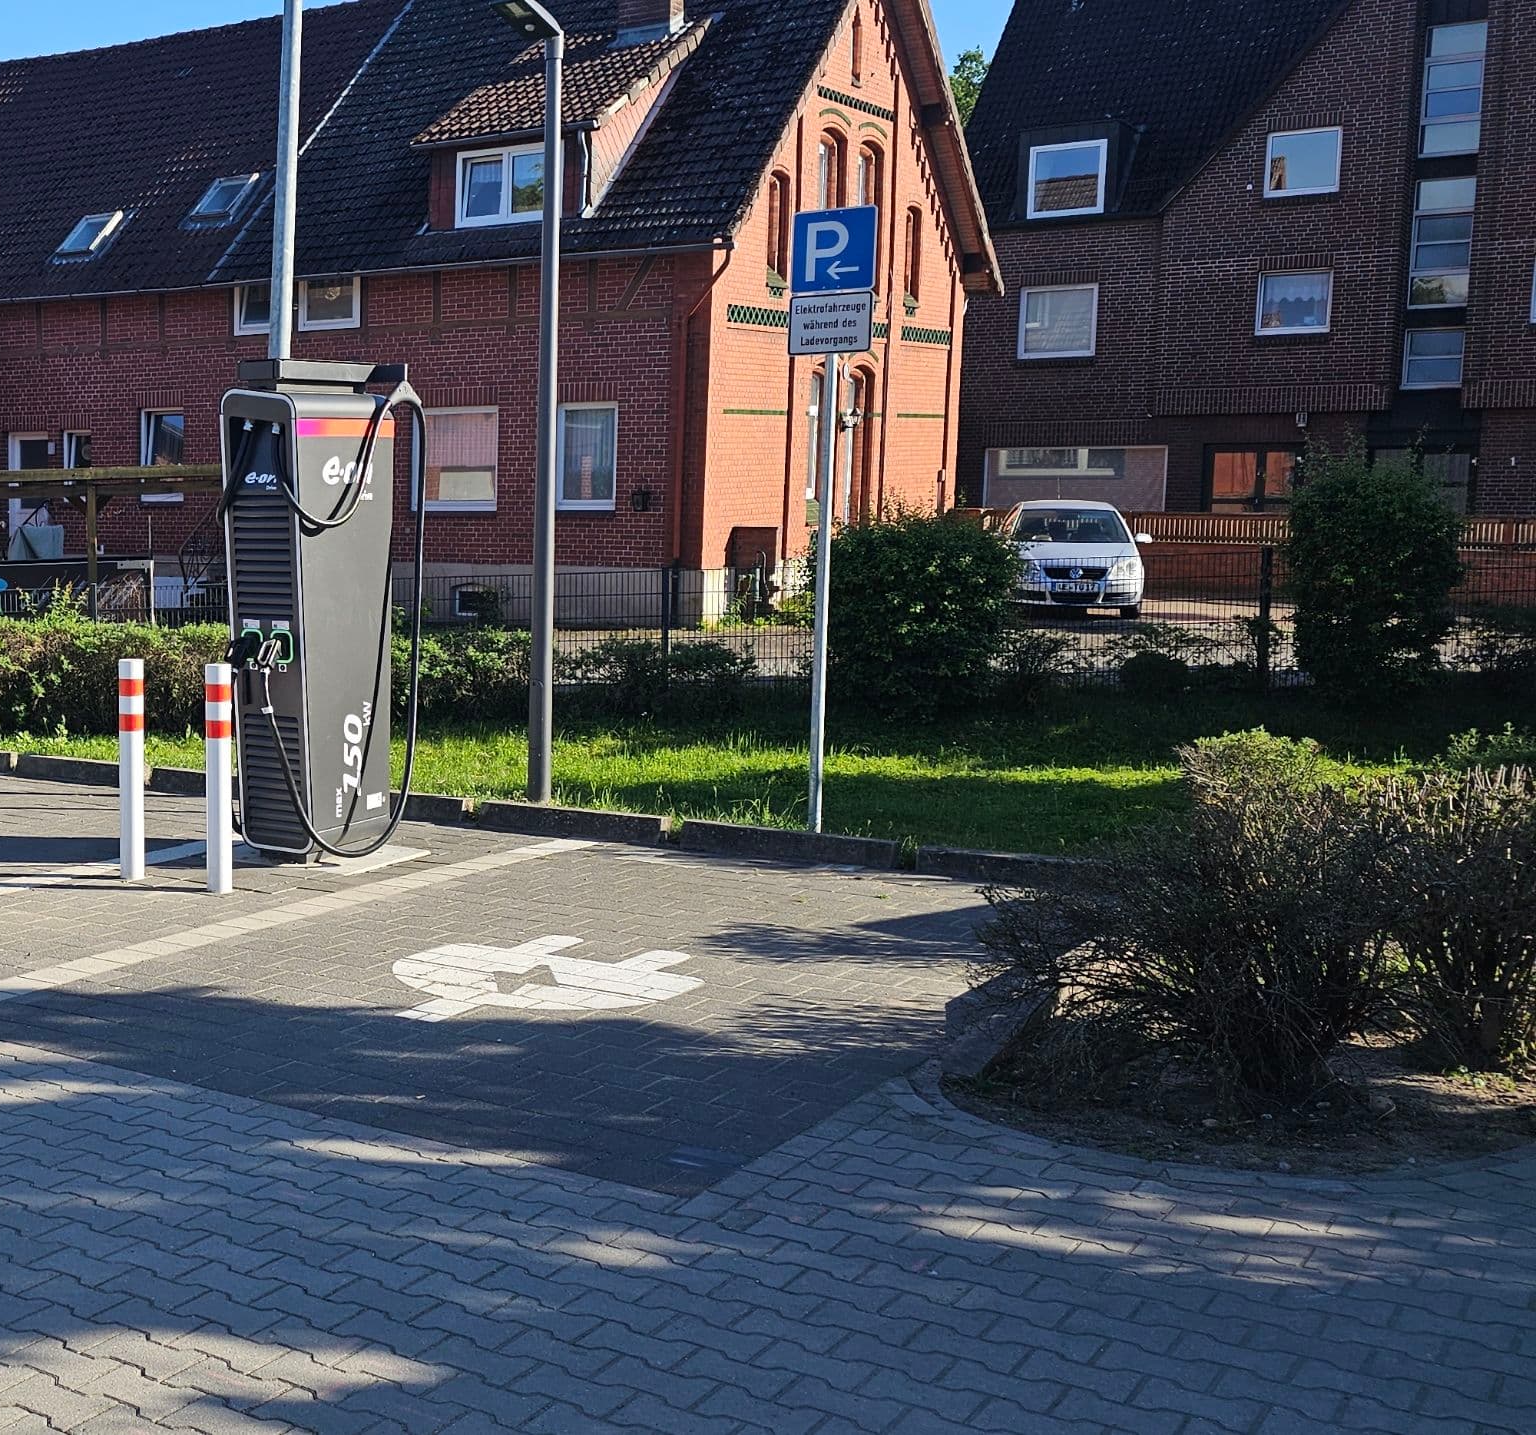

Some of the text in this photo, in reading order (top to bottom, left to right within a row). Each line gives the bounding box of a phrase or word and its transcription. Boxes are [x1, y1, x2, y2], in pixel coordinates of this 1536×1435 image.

[804, 220, 849, 282] P
[795, 302, 867, 315] Elektrofahrzeuge
[802, 317, 857, 330] während des
[800, 335, 858, 347] Ladevorgangs
[335, 701, 372, 818] max 150 kW
